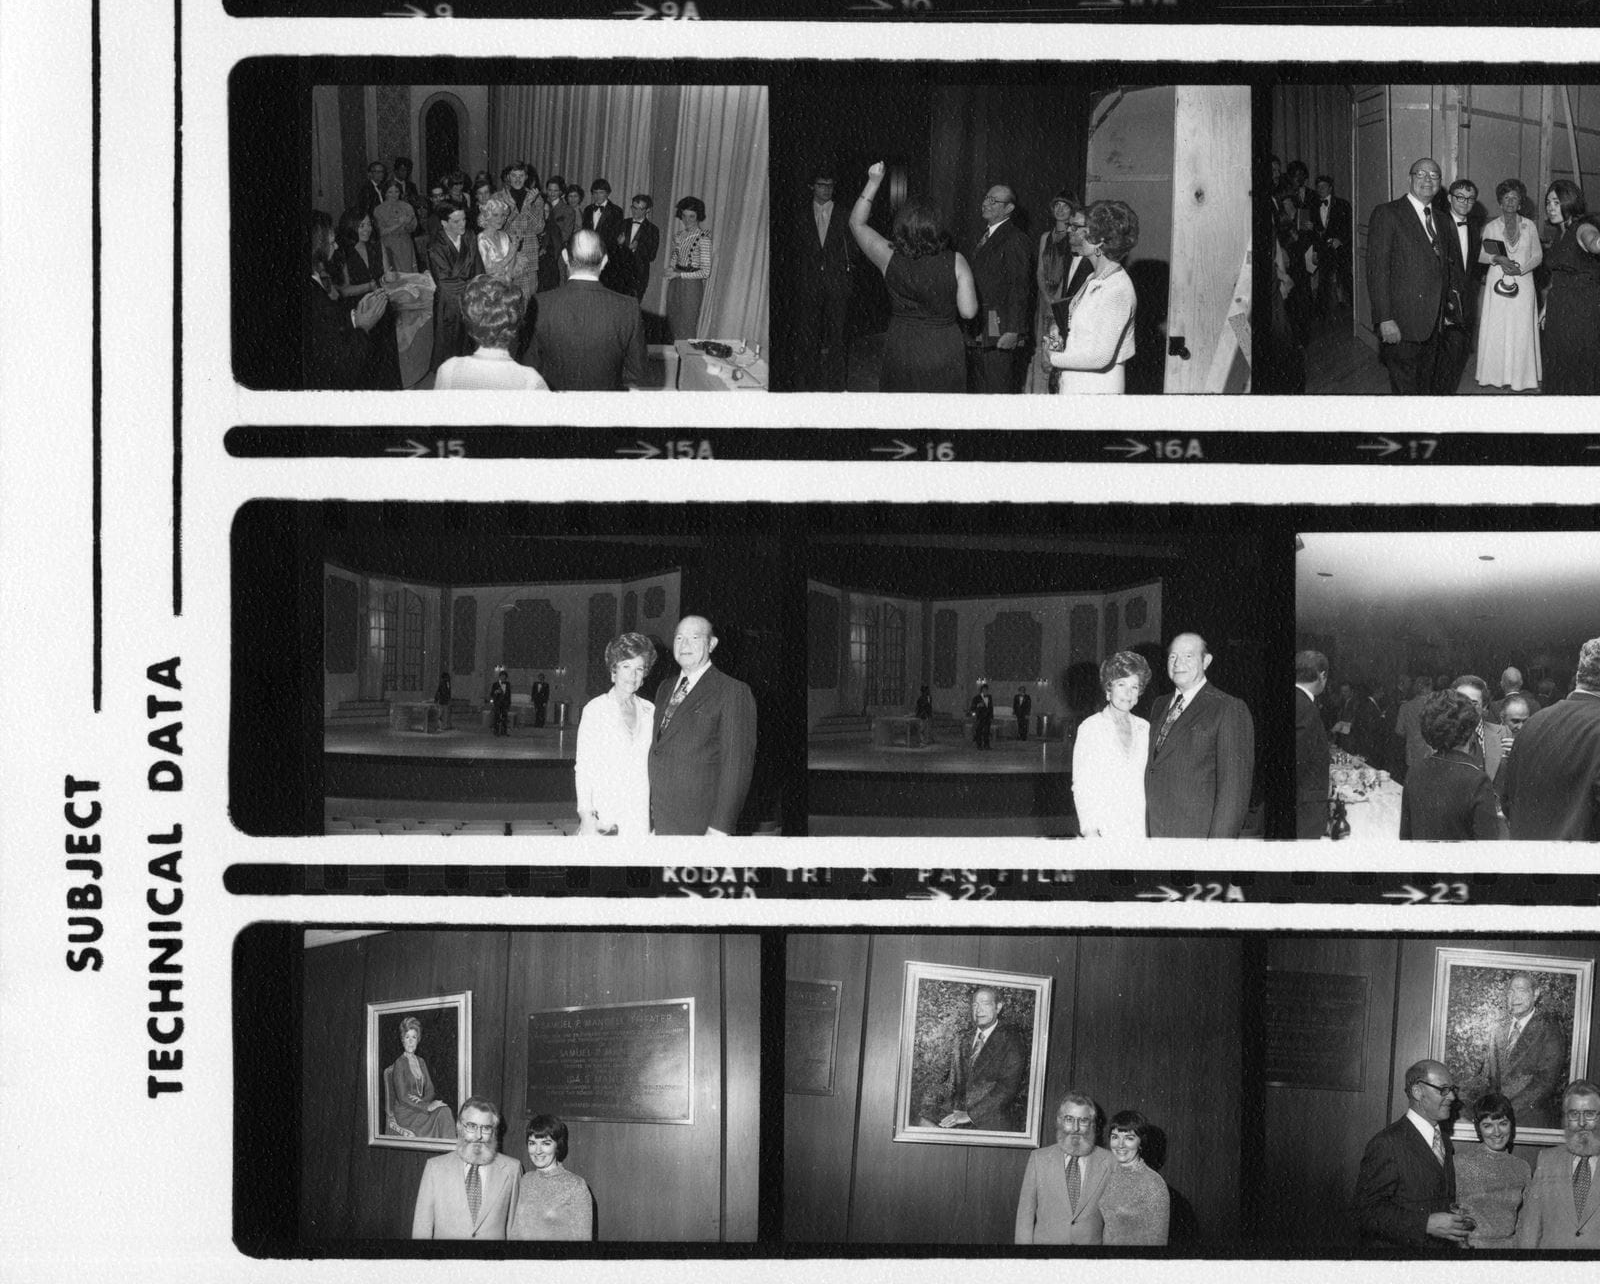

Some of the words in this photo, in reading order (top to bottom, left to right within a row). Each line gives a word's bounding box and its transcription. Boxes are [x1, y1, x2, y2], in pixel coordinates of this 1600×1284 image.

[434, 2, 453, 19] 9
[660, 1, 701, 21] 9A
[435, 439, 466, 459] 15
[664, 439, 715, 459] 15A
[925, 442, 955, 461] 16
[1154, 439, 1205, 459] 16A
[1409, 439, 1439, 459] 17
[145, 655, 185, 792] DATA
[63, 773, 104, 972] SUBJECT
[661, 868, 759, 884] KODAK
[861, 868, 878, 883] X
[917, 869, 979, 883] PAN
[959, 884, 997, 900] 22
[1183, 883, 1245, 902] 22A
[1429, 883, 1471, 903] 23
[145, 821, 185, 1099] TECHNICAL
